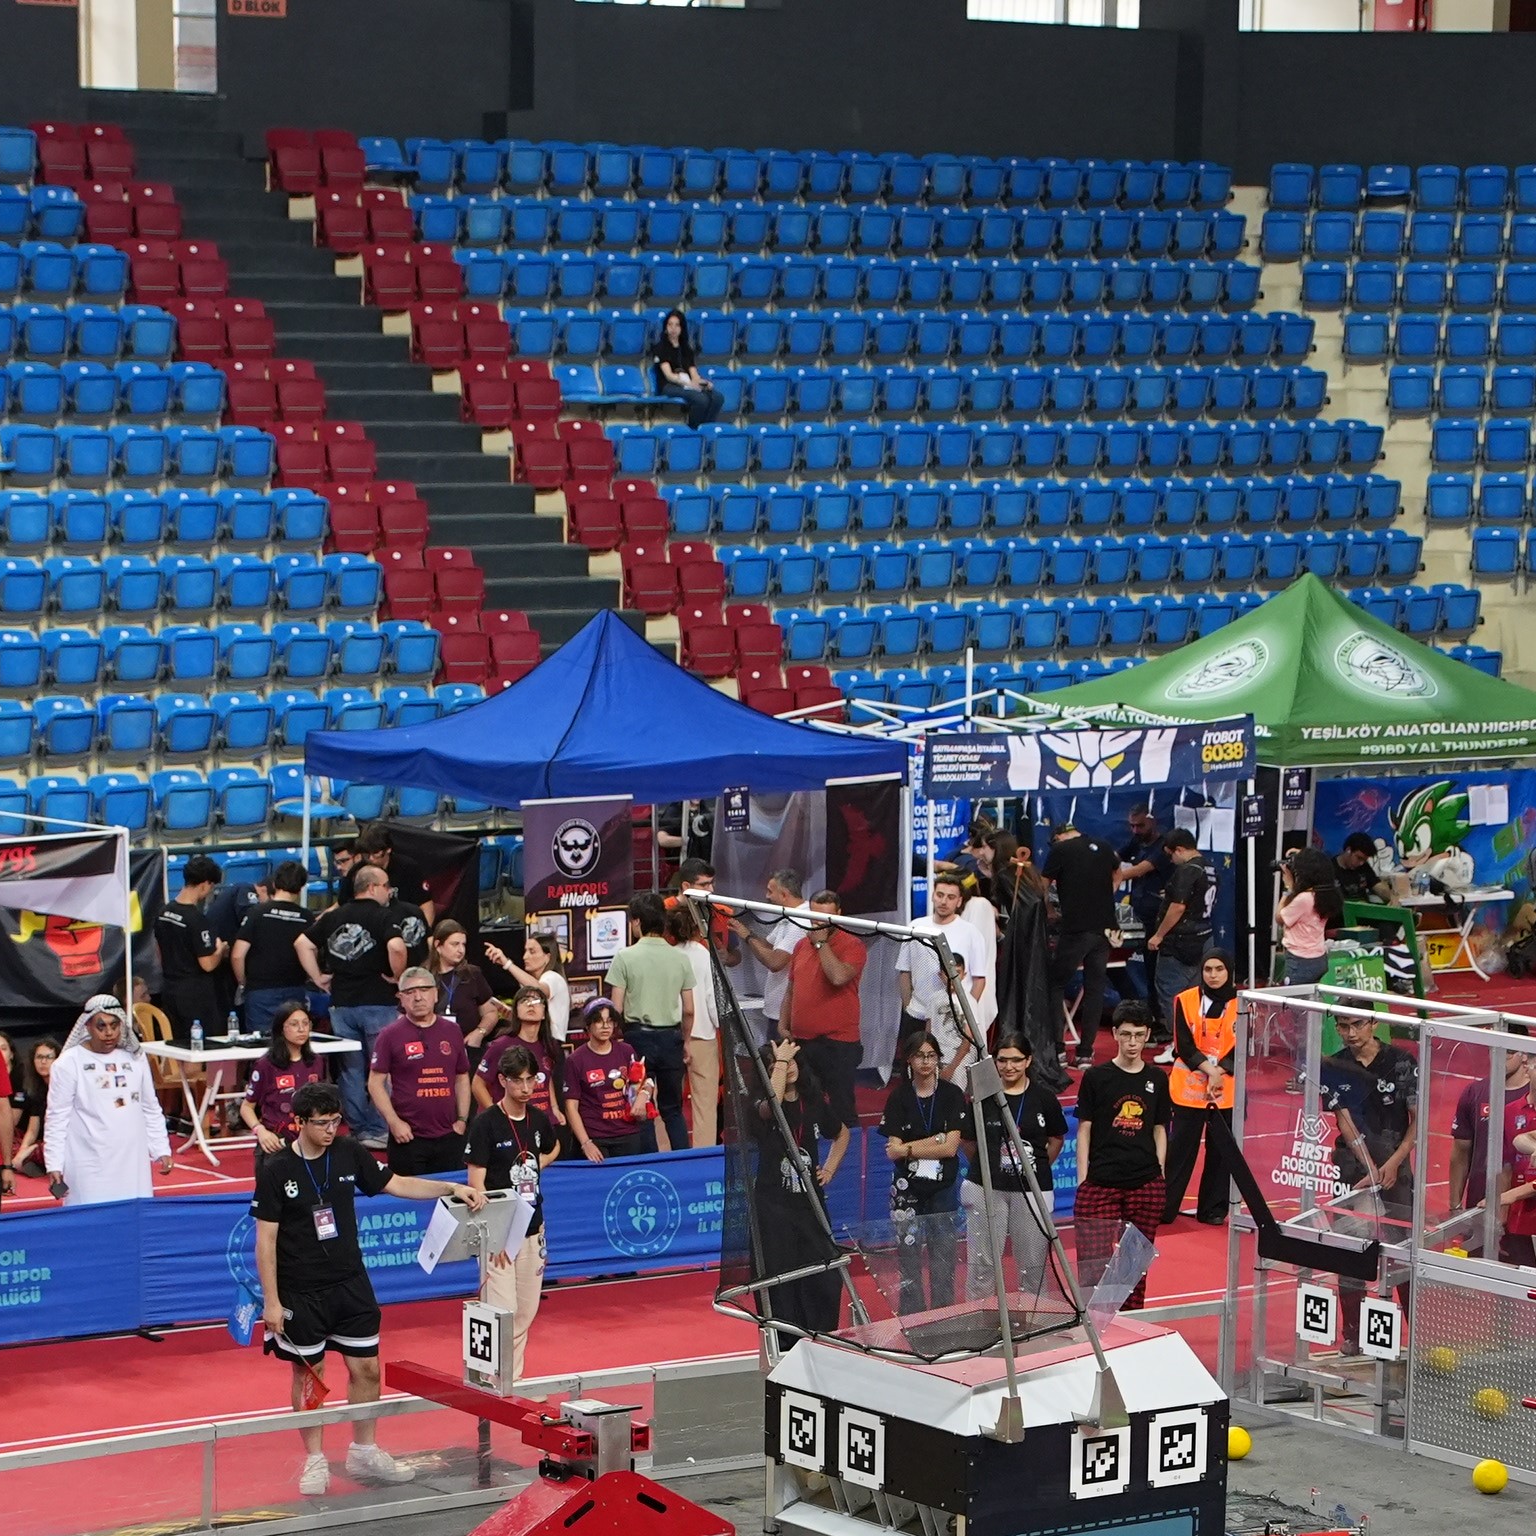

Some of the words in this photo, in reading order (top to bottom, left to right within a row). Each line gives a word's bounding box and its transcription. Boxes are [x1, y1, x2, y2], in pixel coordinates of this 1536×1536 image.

[245, 0, 281, 13] BLOK
[1300, 724, 1382, 742] YEŞİLKÖY
[1384, 720, 1479, 738] ANATOLIAN
[1202, 742, 1244, 763] 6038
[1407, 742, 1440, 754] YAL
[547, 882, 609, 899] RAPTORIS
[559, 892, 599, 908] #Nefes
[1291, 1140, 1332, 1162] FIRST
[1281, 1155, 1341, 1180] ROBOTICS
[1271, 1169, 1351, 1197] COMPETITION
[383, 1232, 401, 1246] VE
[12, 1267, 52, 1284] SPOR
